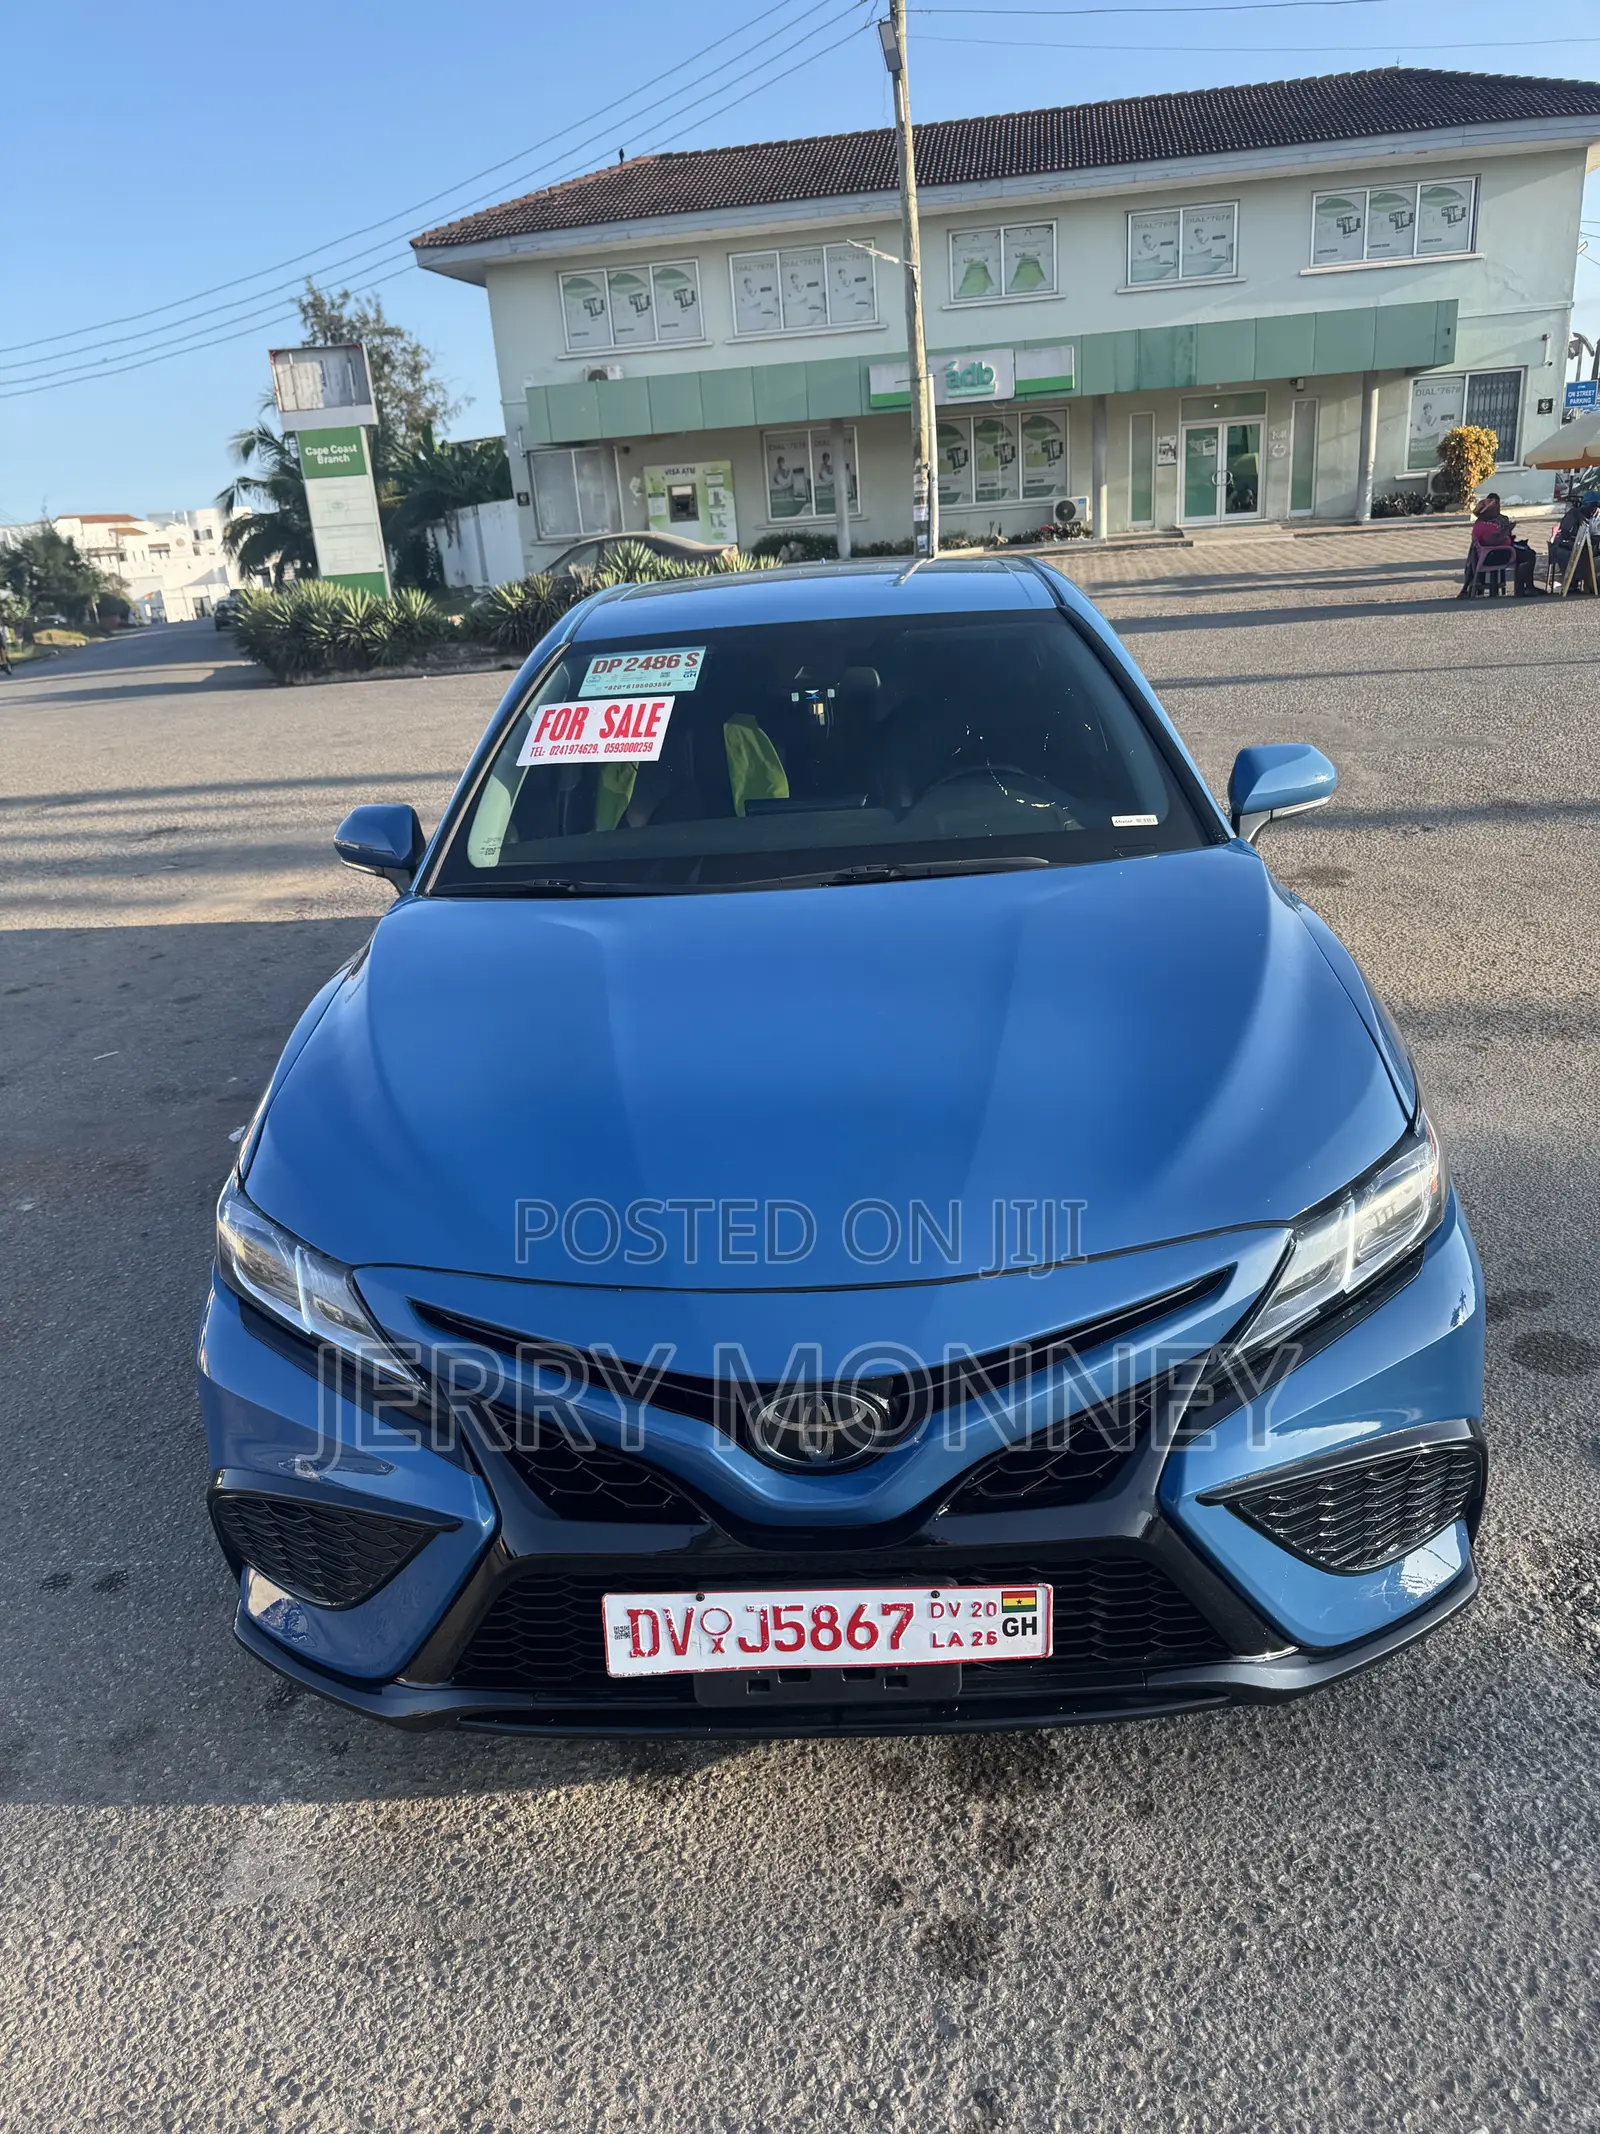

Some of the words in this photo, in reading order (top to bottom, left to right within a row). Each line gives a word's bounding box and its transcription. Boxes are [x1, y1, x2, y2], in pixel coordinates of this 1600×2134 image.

[1576, 389, 1596, 398] STREET
[1569, 398, 1592, 406] PARKING
[304, 446, 329, 457] Cape
[329, 443, 358, 454] Coast
[316, 453, 351, 465] Branch
[665, 467, 680, 476] VISA
[591, 658, 623, 675] DP
[623, 653, 682, 673] 2486
[684, 651, 700, 668] S
[533, 706, 590, 743] FOR
[599, 702, 666, 739] SALE
[603, 741, 654, 754] 0593000259
[929, 1600, 963, 1619] DV
[970, 1600, 999, 1619] 20
[626, 1606, 695, 1659] DV
[737, 1602, 915, 1653] J5867
[1001, 1615, 1038, 1638] GH
[931, 1631, 965, 1649] LA
